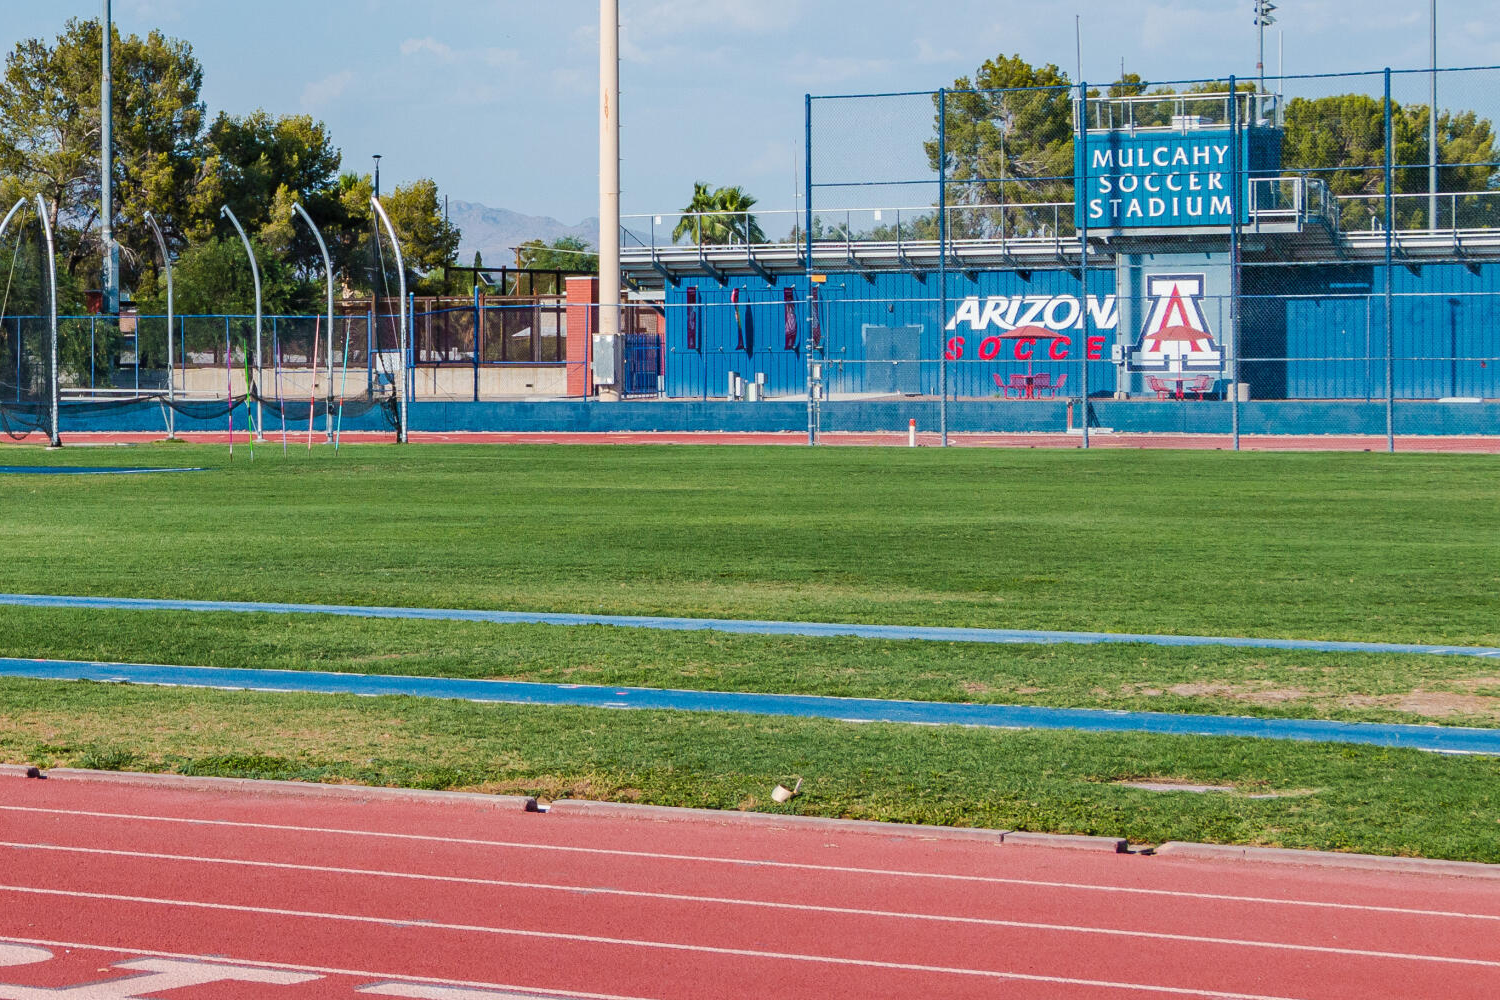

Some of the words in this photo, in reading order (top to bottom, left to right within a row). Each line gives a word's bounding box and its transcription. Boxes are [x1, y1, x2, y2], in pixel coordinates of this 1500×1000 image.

[1091, 145, 1229, 169] MULCAHY
[1099, 171, 1223, 194] SOCCER
[1089, 195, 1232, 219] STADIUM
